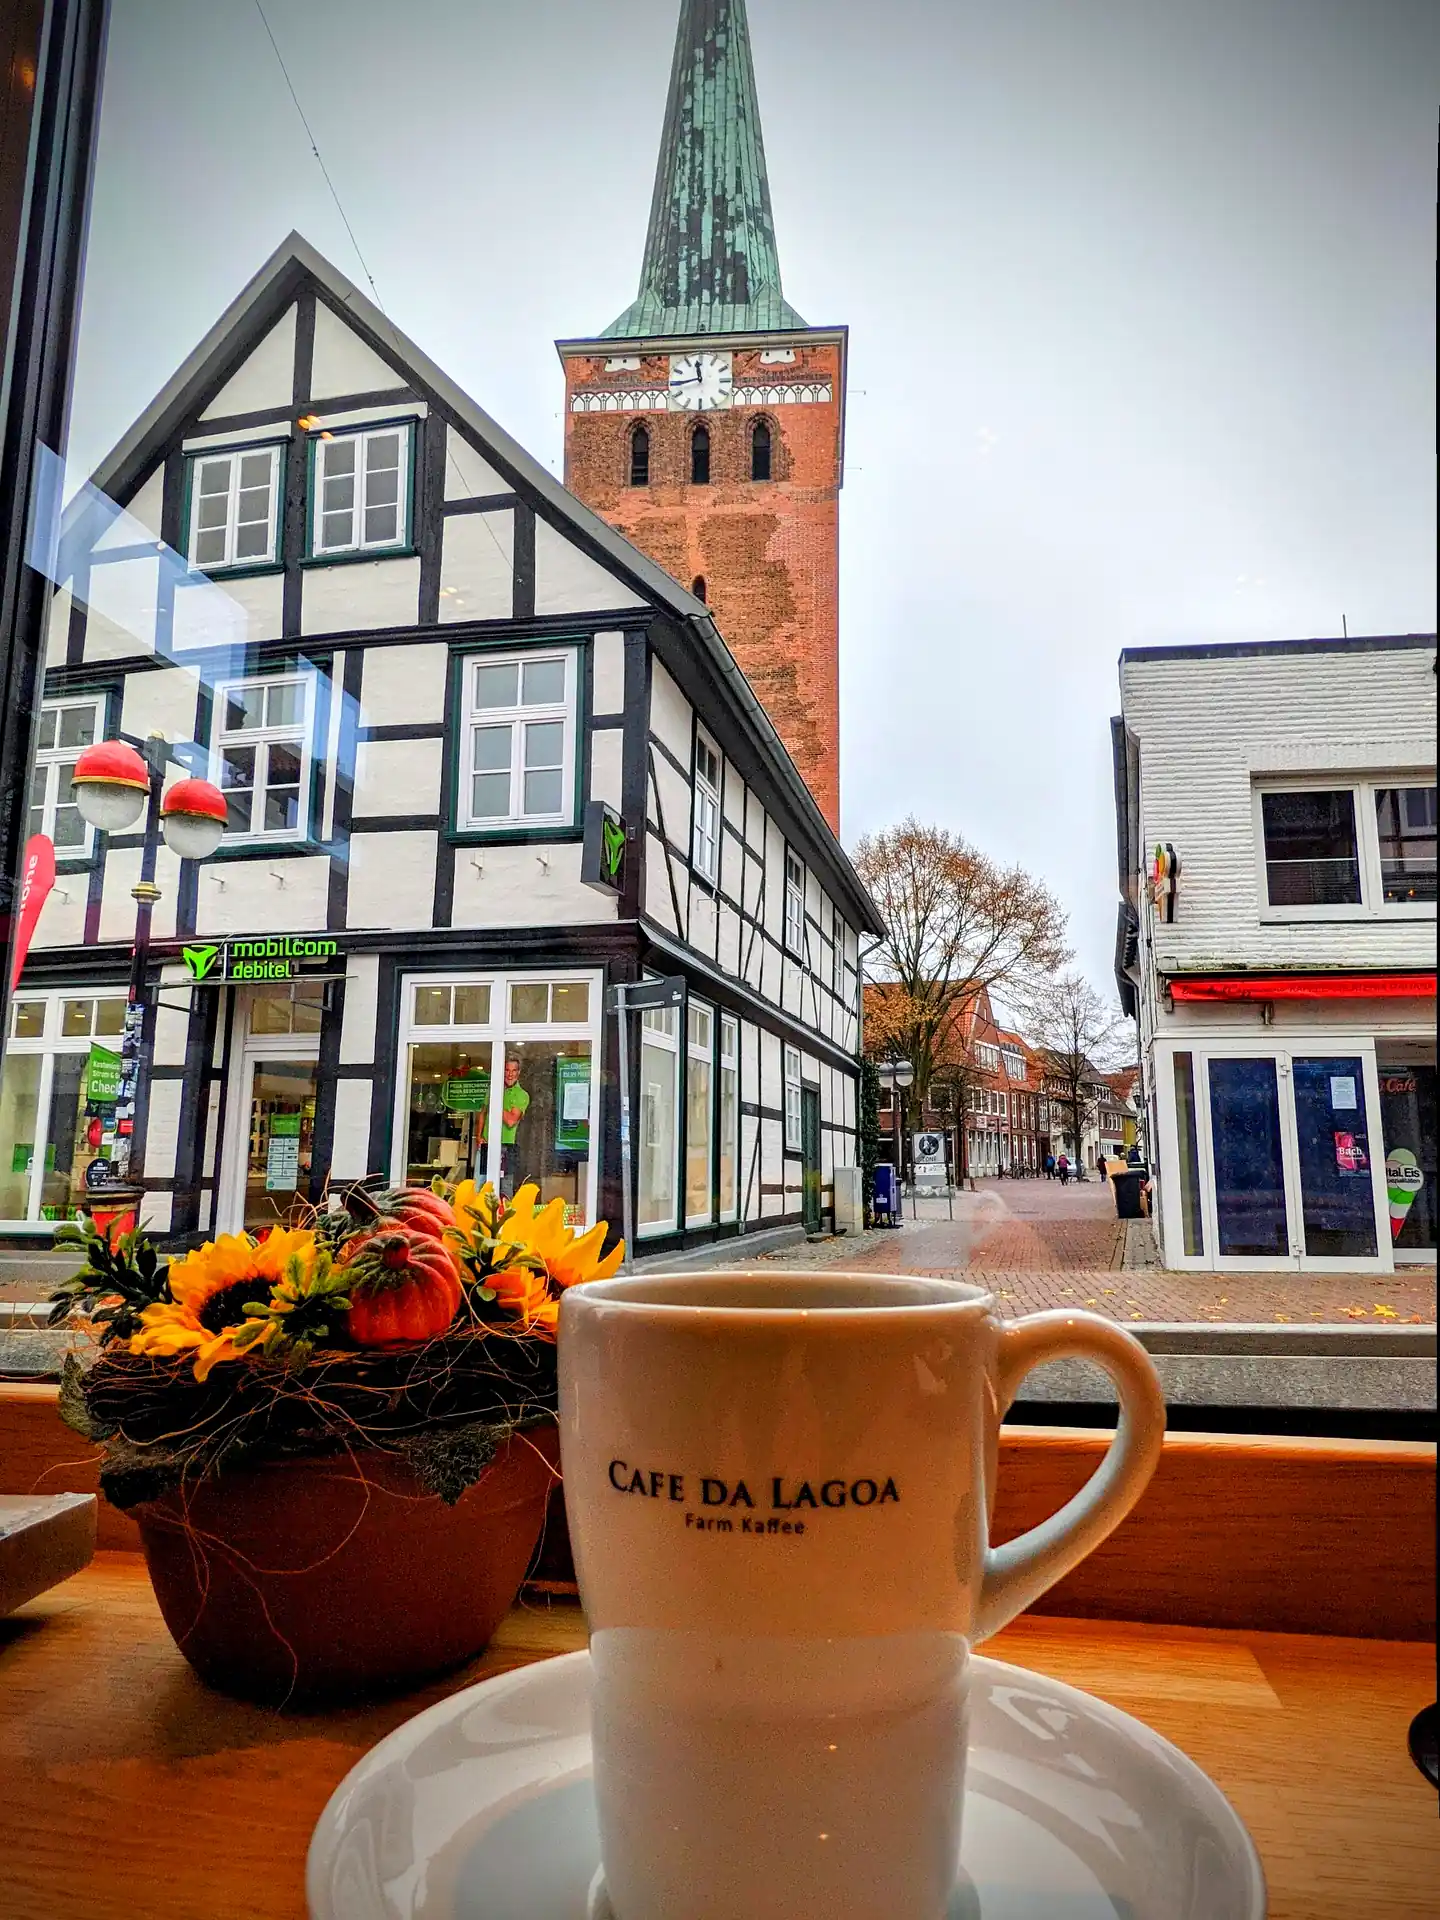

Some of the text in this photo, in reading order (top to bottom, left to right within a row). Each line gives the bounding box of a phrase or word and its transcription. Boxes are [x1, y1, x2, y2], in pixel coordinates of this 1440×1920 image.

[234, 937, 337, 957] mobilcom
[233, 959, 292, 978] debitel
[1404, 1168, 1420, 1178] Eis
[608, 1459, 900, 1510] CAFE DA LAGOA
[685, 1512, 805, 1535] Farm Kaffee
